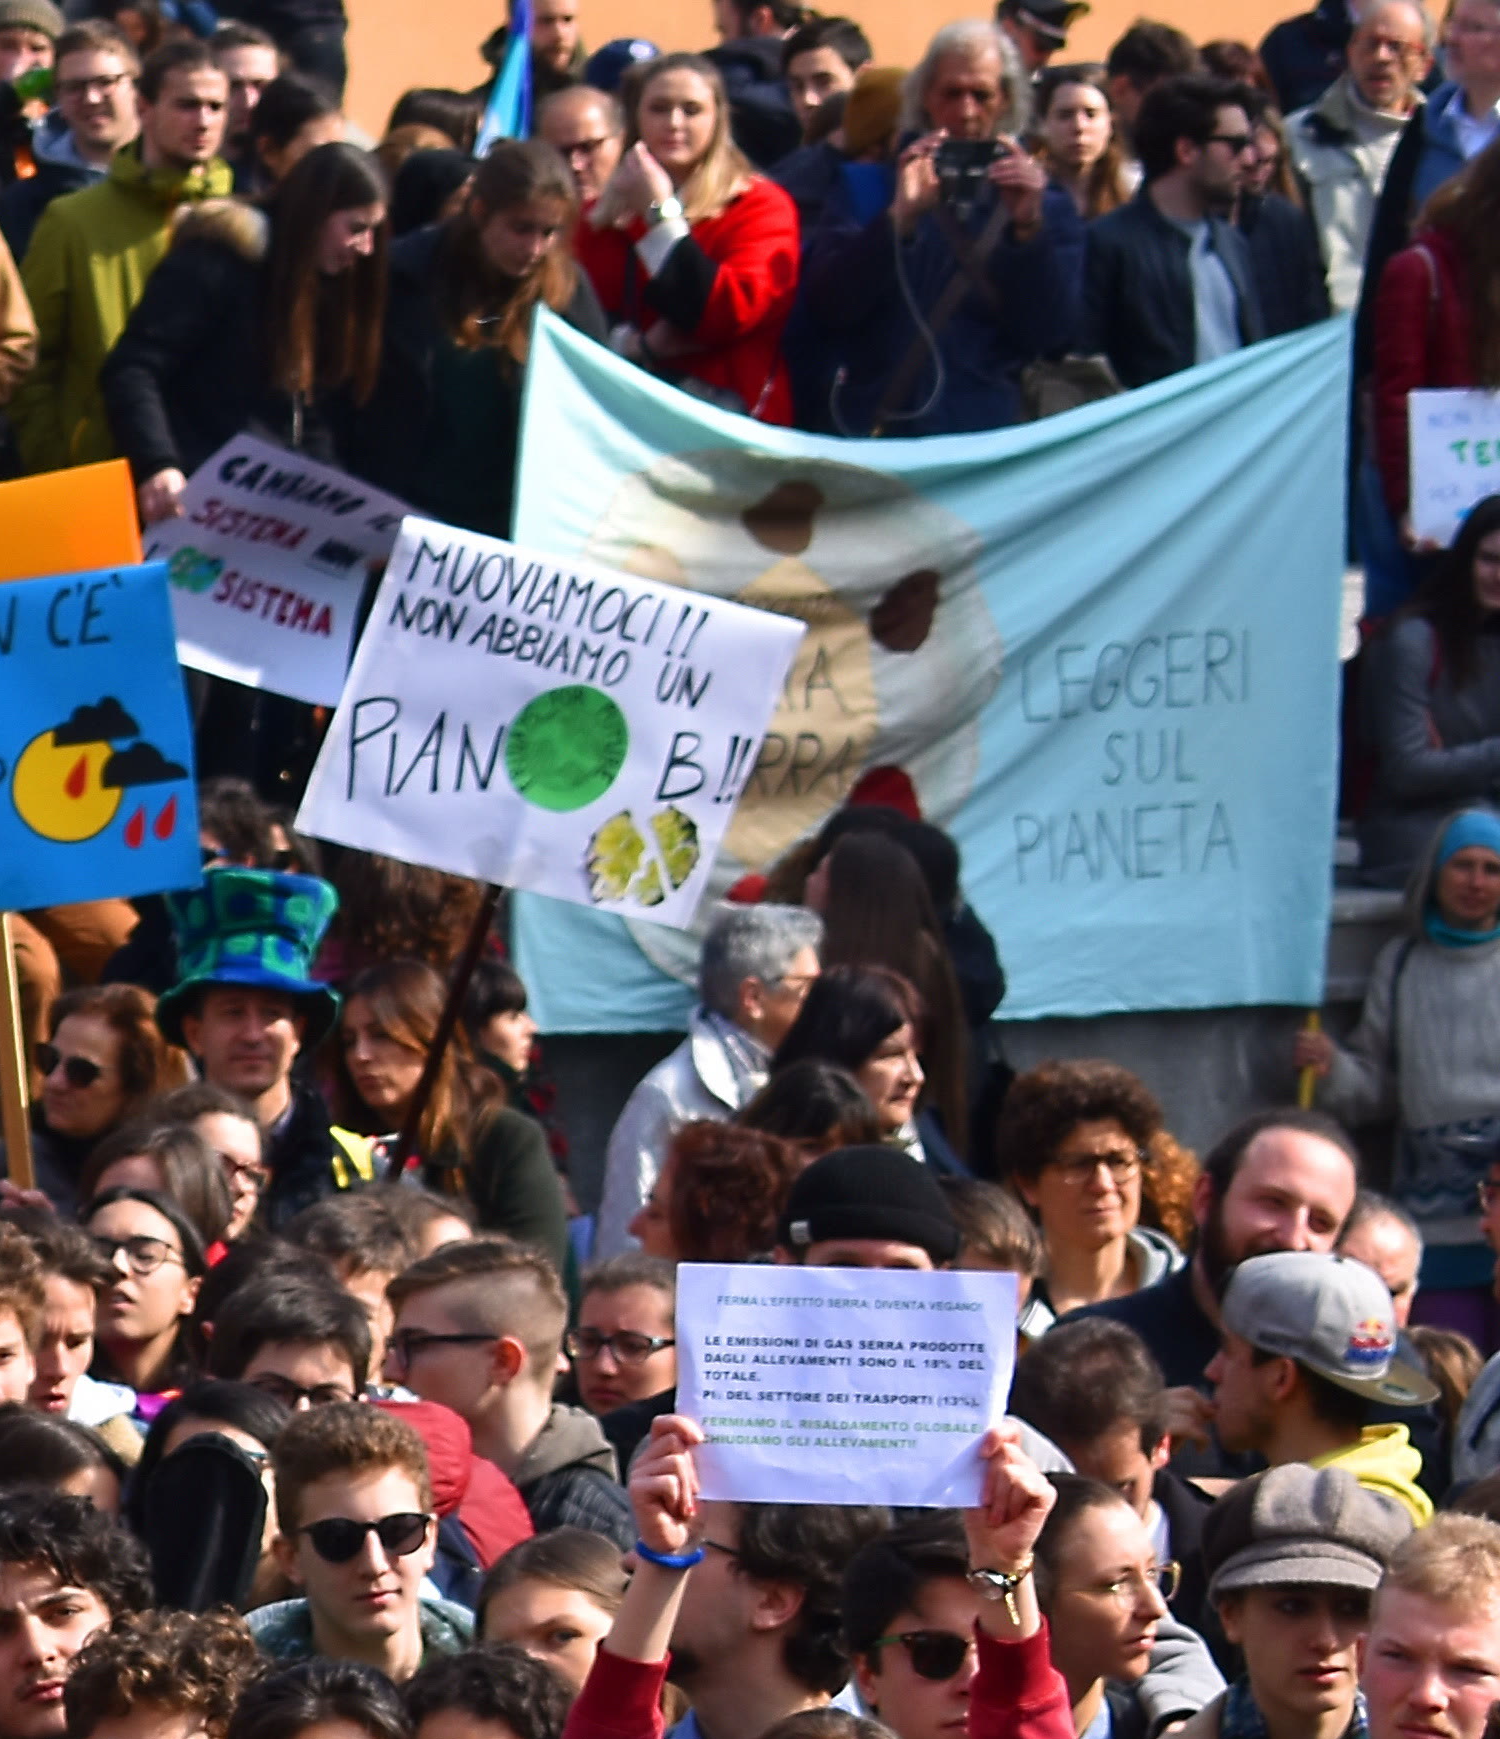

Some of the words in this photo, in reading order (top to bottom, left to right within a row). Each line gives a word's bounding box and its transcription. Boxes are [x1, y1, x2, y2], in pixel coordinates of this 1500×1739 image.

[389, 591, 465, 641] NON
[469, 610, 629, 687] ABBIAMO
[656, 656, 713, 708] UN
[1021, 629, 1250, 723] LEGGERI
[1103, 728, 1197, 785] SUL
[1014, 800, 1241, 884] PIANETA
[704, 1336, 720, 1346] LE
[726, 1337, 799, 1347] EMISSIONI
[804, 1338, 818, 1348] DI
[824, 1339, 852, 1349] GAS
[859, 1340, 904, 1350] SERRA
[909, 1342, 985, 1353] PRODOTTE
[704, 1353, 745, 1363] DAGLI
[752, 1355, 851, 1366] ALLEVAMENTI
[858, 1358, 897, 1368] SONO
[958, 1360, 985, 1370] DEL
[726, 1391, 752, 1401] DEL
[757, 1391, 821, 1402] SETTORE
[826, 1393, 850, 1403] DEI
[854, 1394, 932, 1404] TRASPORTI
[702, 1417, 776, 1427] FERMIAMO
